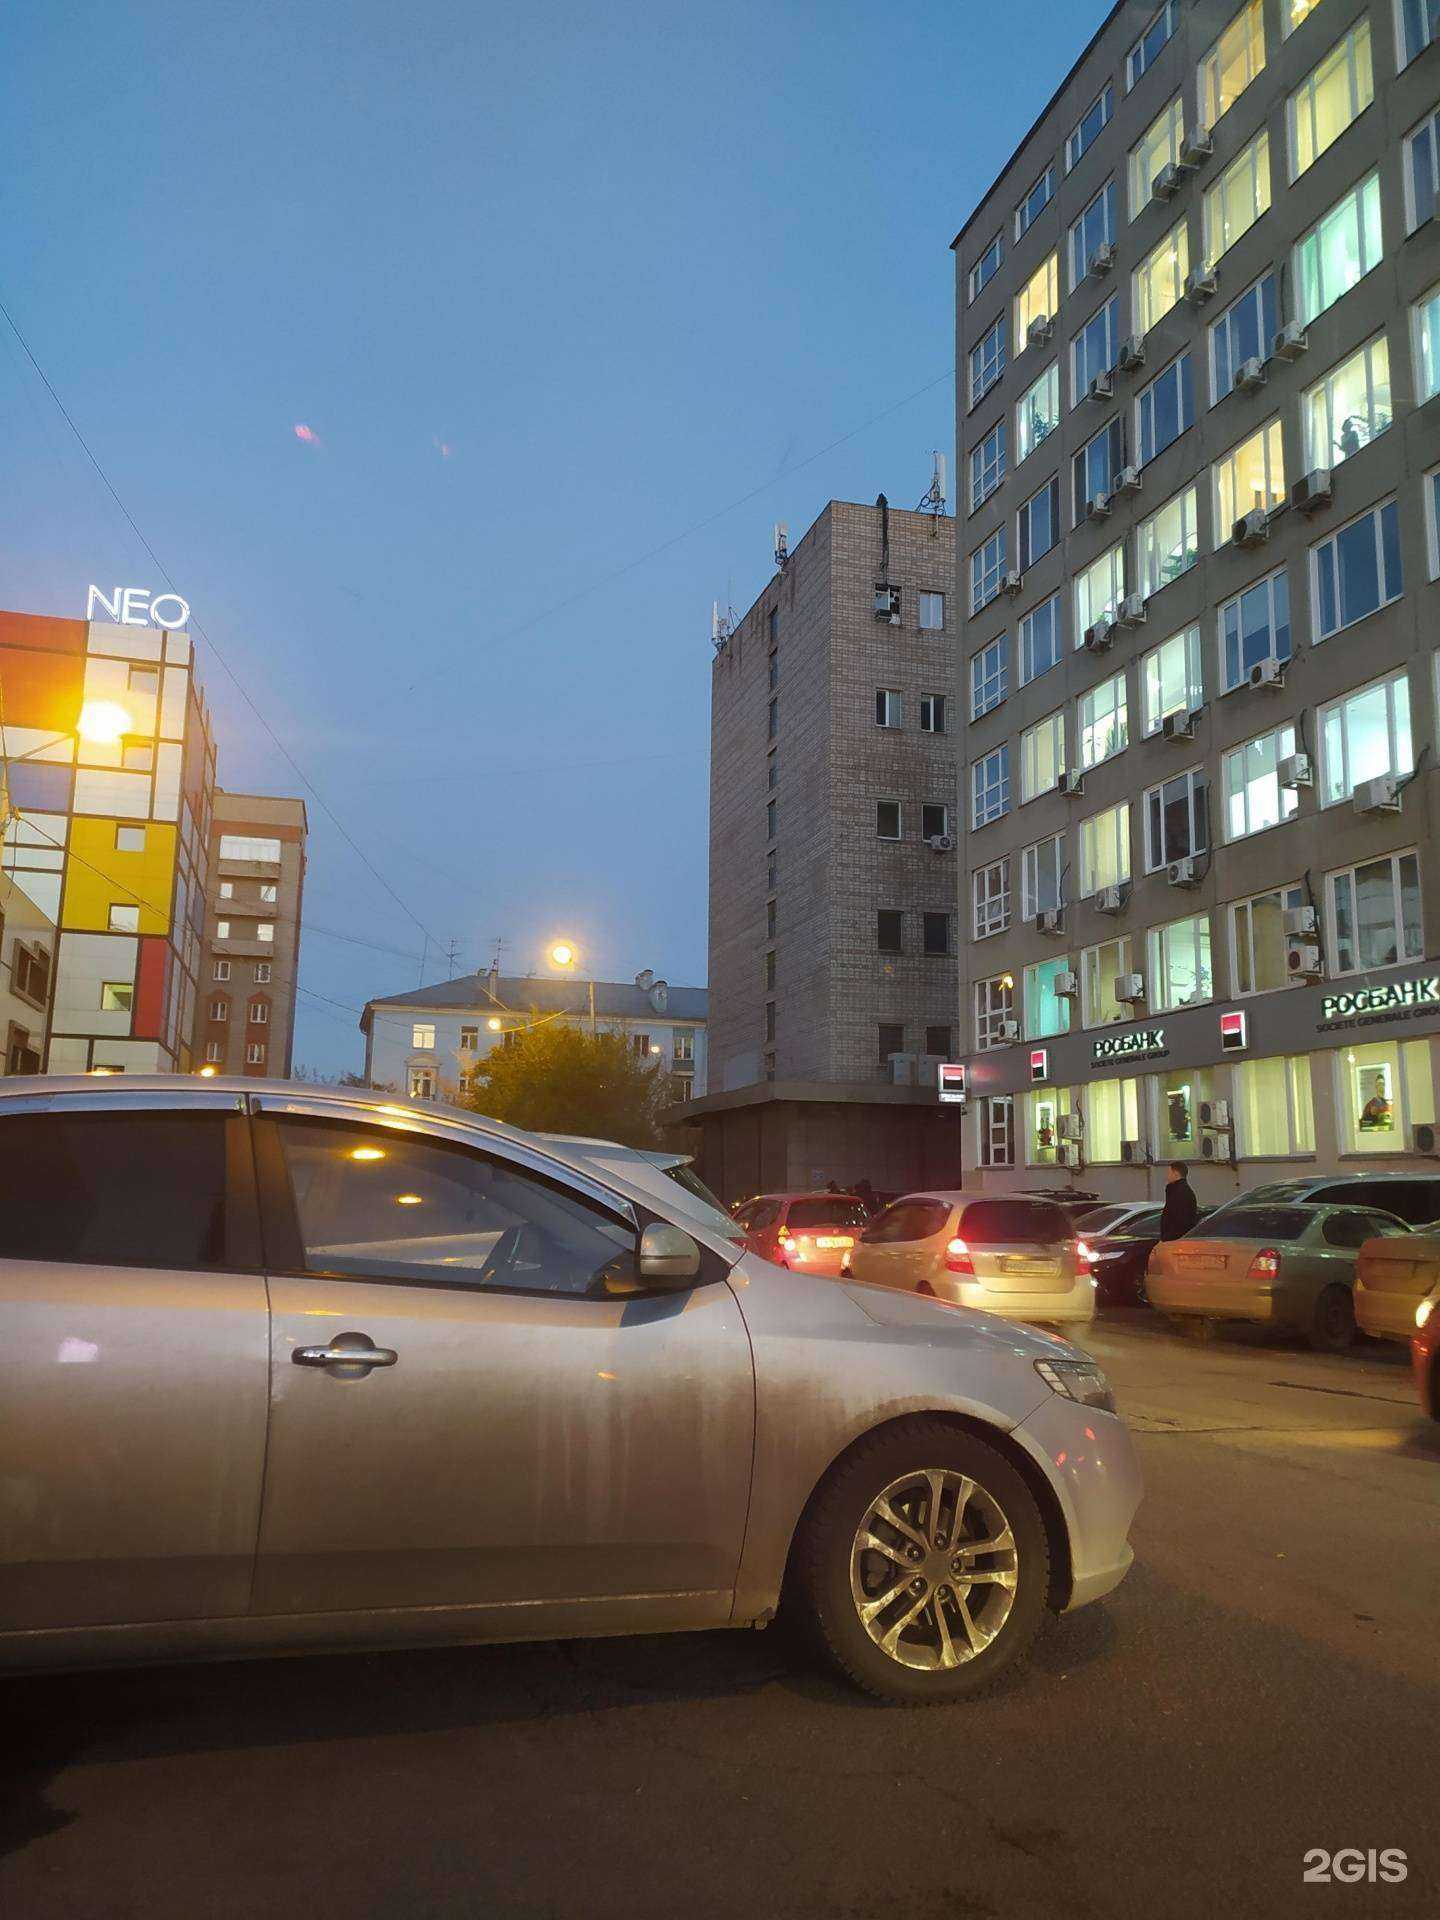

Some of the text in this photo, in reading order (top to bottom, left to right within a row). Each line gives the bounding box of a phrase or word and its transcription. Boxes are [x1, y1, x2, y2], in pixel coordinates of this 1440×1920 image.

[87, 585, 190, 629] NEO
[1321, 978, 1439, 1018] РОСБАНК
[1093, 1029, 1164, 1057] РОСБАНК
